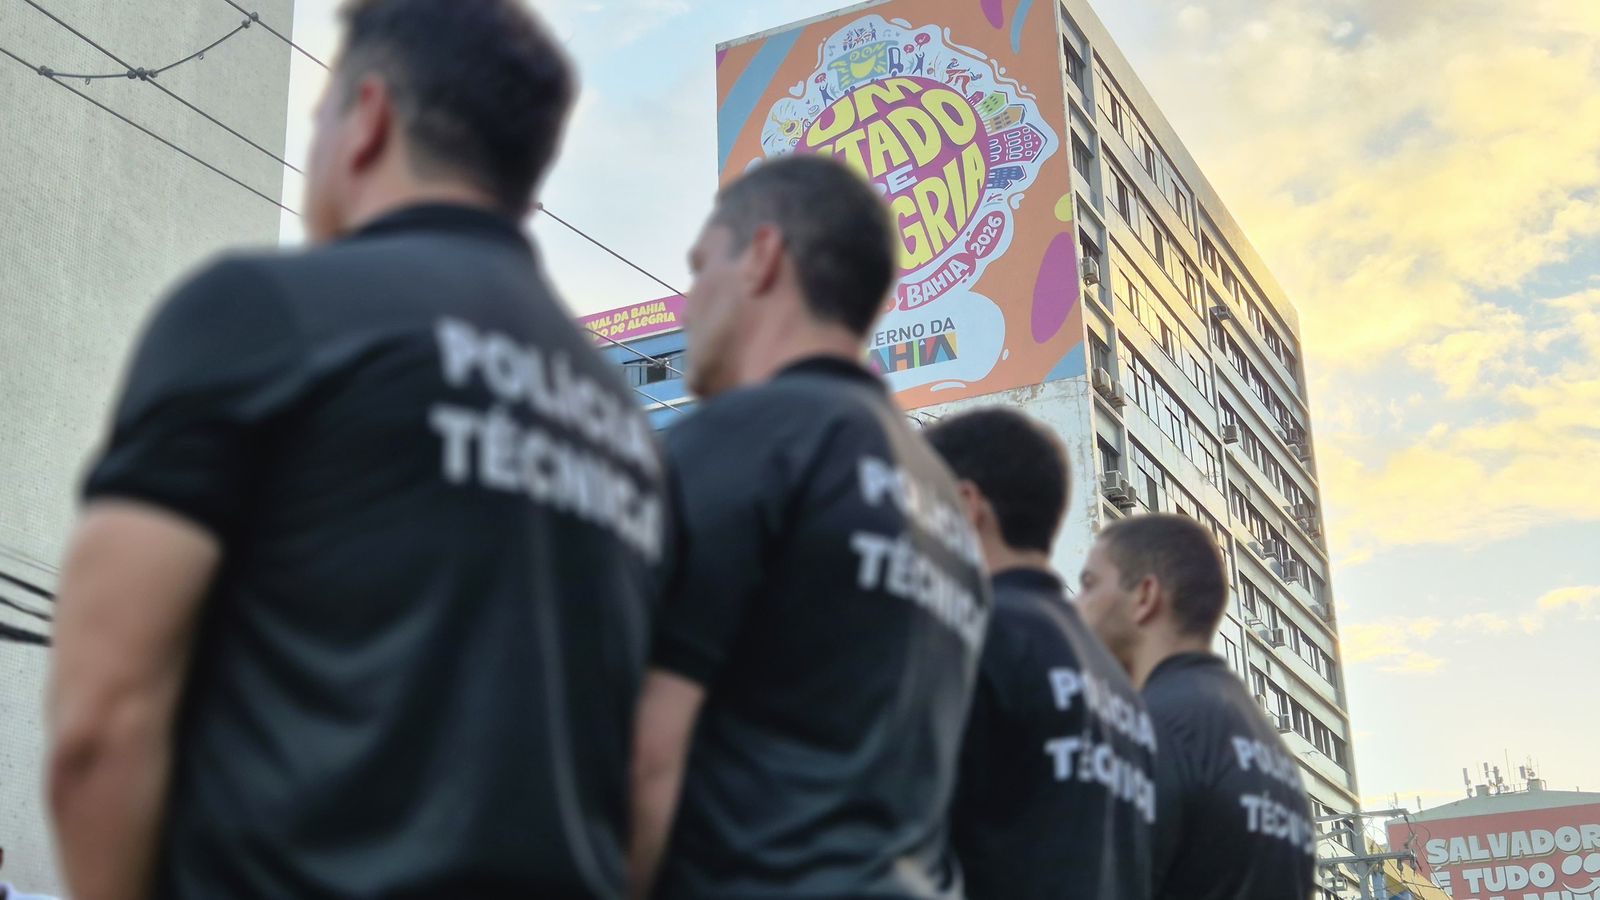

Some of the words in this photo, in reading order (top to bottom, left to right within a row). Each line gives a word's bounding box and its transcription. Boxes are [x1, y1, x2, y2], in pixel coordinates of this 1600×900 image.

[806, 78, 924, 147] UM
[816, 88, 977, 181] TADO
[873, 164, 918, 197] E
[890, 141, 986, 270] GRIA
[906, 259, 969, 308] BAHIA
[971, 216, 1003, 256] 2026
[614, 312, 628, 324] DA
[631, 303, 666, 317] BAHIA
[875, 323, 925, 347] ERNO
[930, 317, 956, 334] DA
[1426, 824, 1600, 864] SALVADOR
[1463, 863, 1556, 894] TUDO
